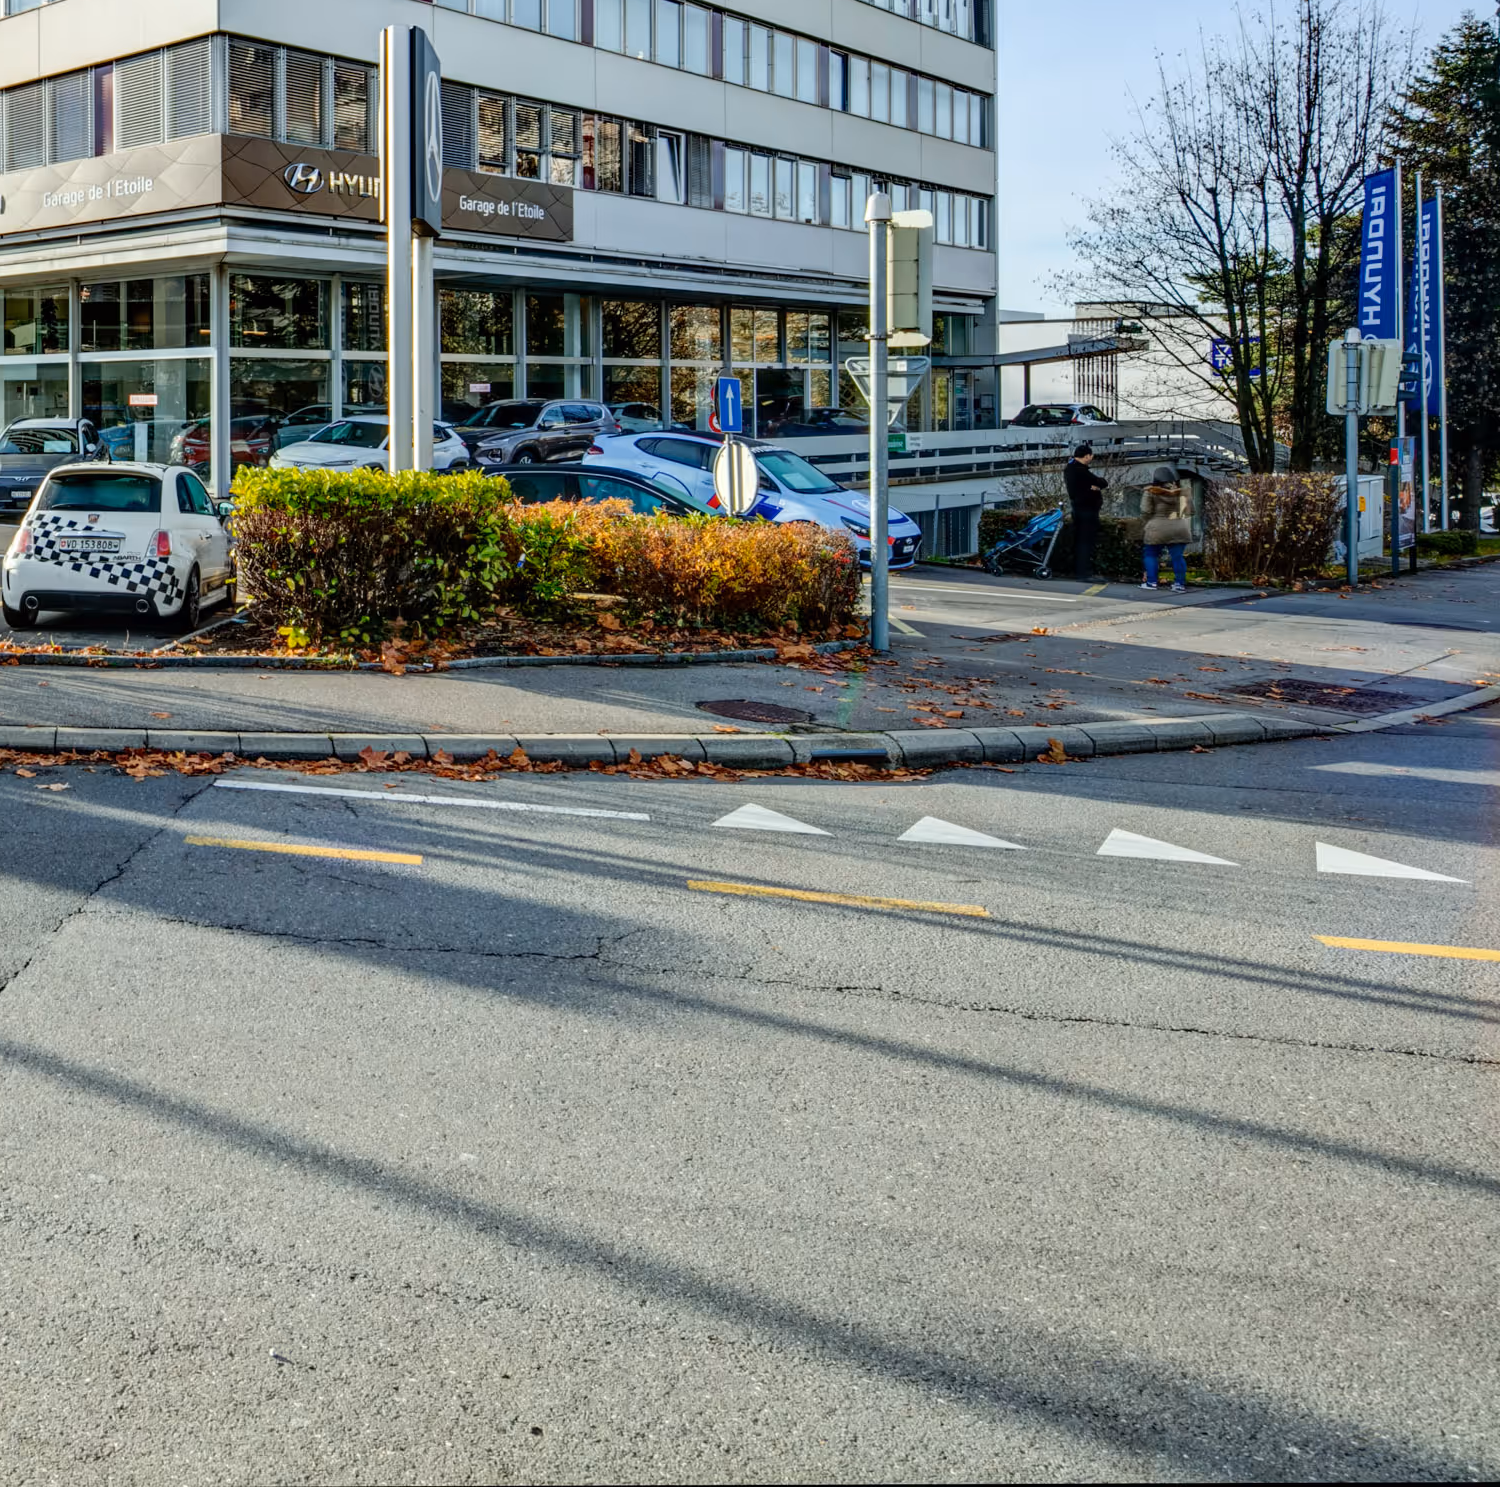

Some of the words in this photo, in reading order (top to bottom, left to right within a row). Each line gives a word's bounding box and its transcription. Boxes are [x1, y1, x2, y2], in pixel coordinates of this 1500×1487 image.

[43, 189, 85, 209] Garage
[88, 183, 103, 200] de
[459, 194, 496, 217] Garage
[497, 197, 510, 215] de
[66, 539, 77, 549] VD
